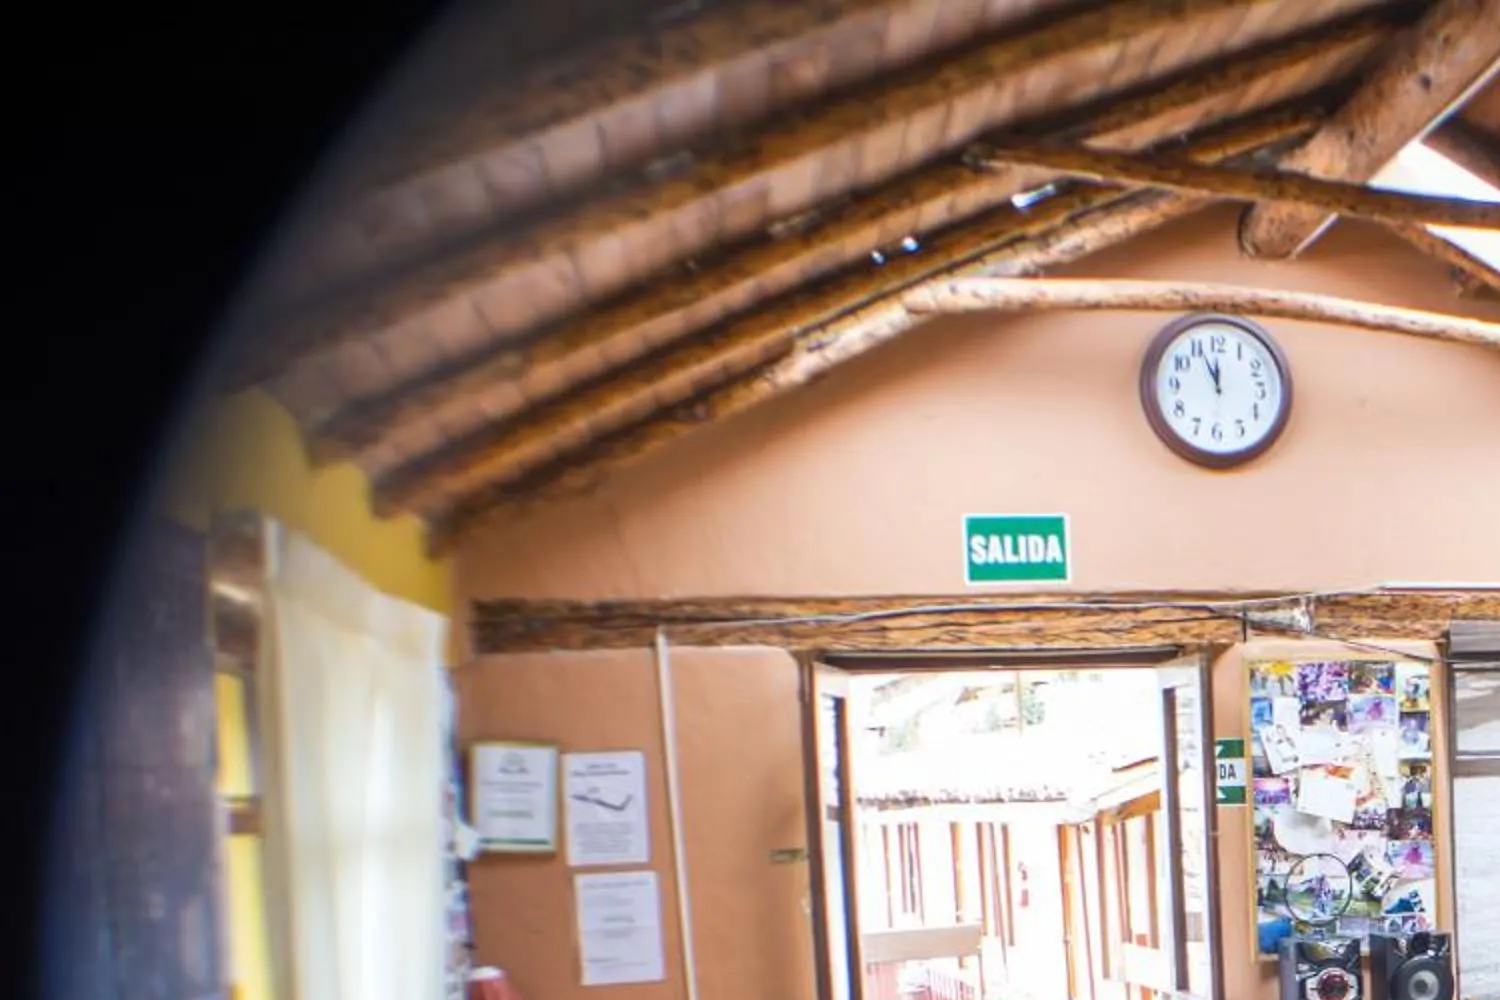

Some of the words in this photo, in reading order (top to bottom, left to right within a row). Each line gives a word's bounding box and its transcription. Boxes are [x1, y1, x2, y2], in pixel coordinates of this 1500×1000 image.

[1211, 336, 1226, 353] 12
[1174, 355, 1190, 372] 10
[1173, 399, 1185, 417] 8
[1192, 417, 1201, 436] 7
[971, 534, 1064, 565] SALIDA
